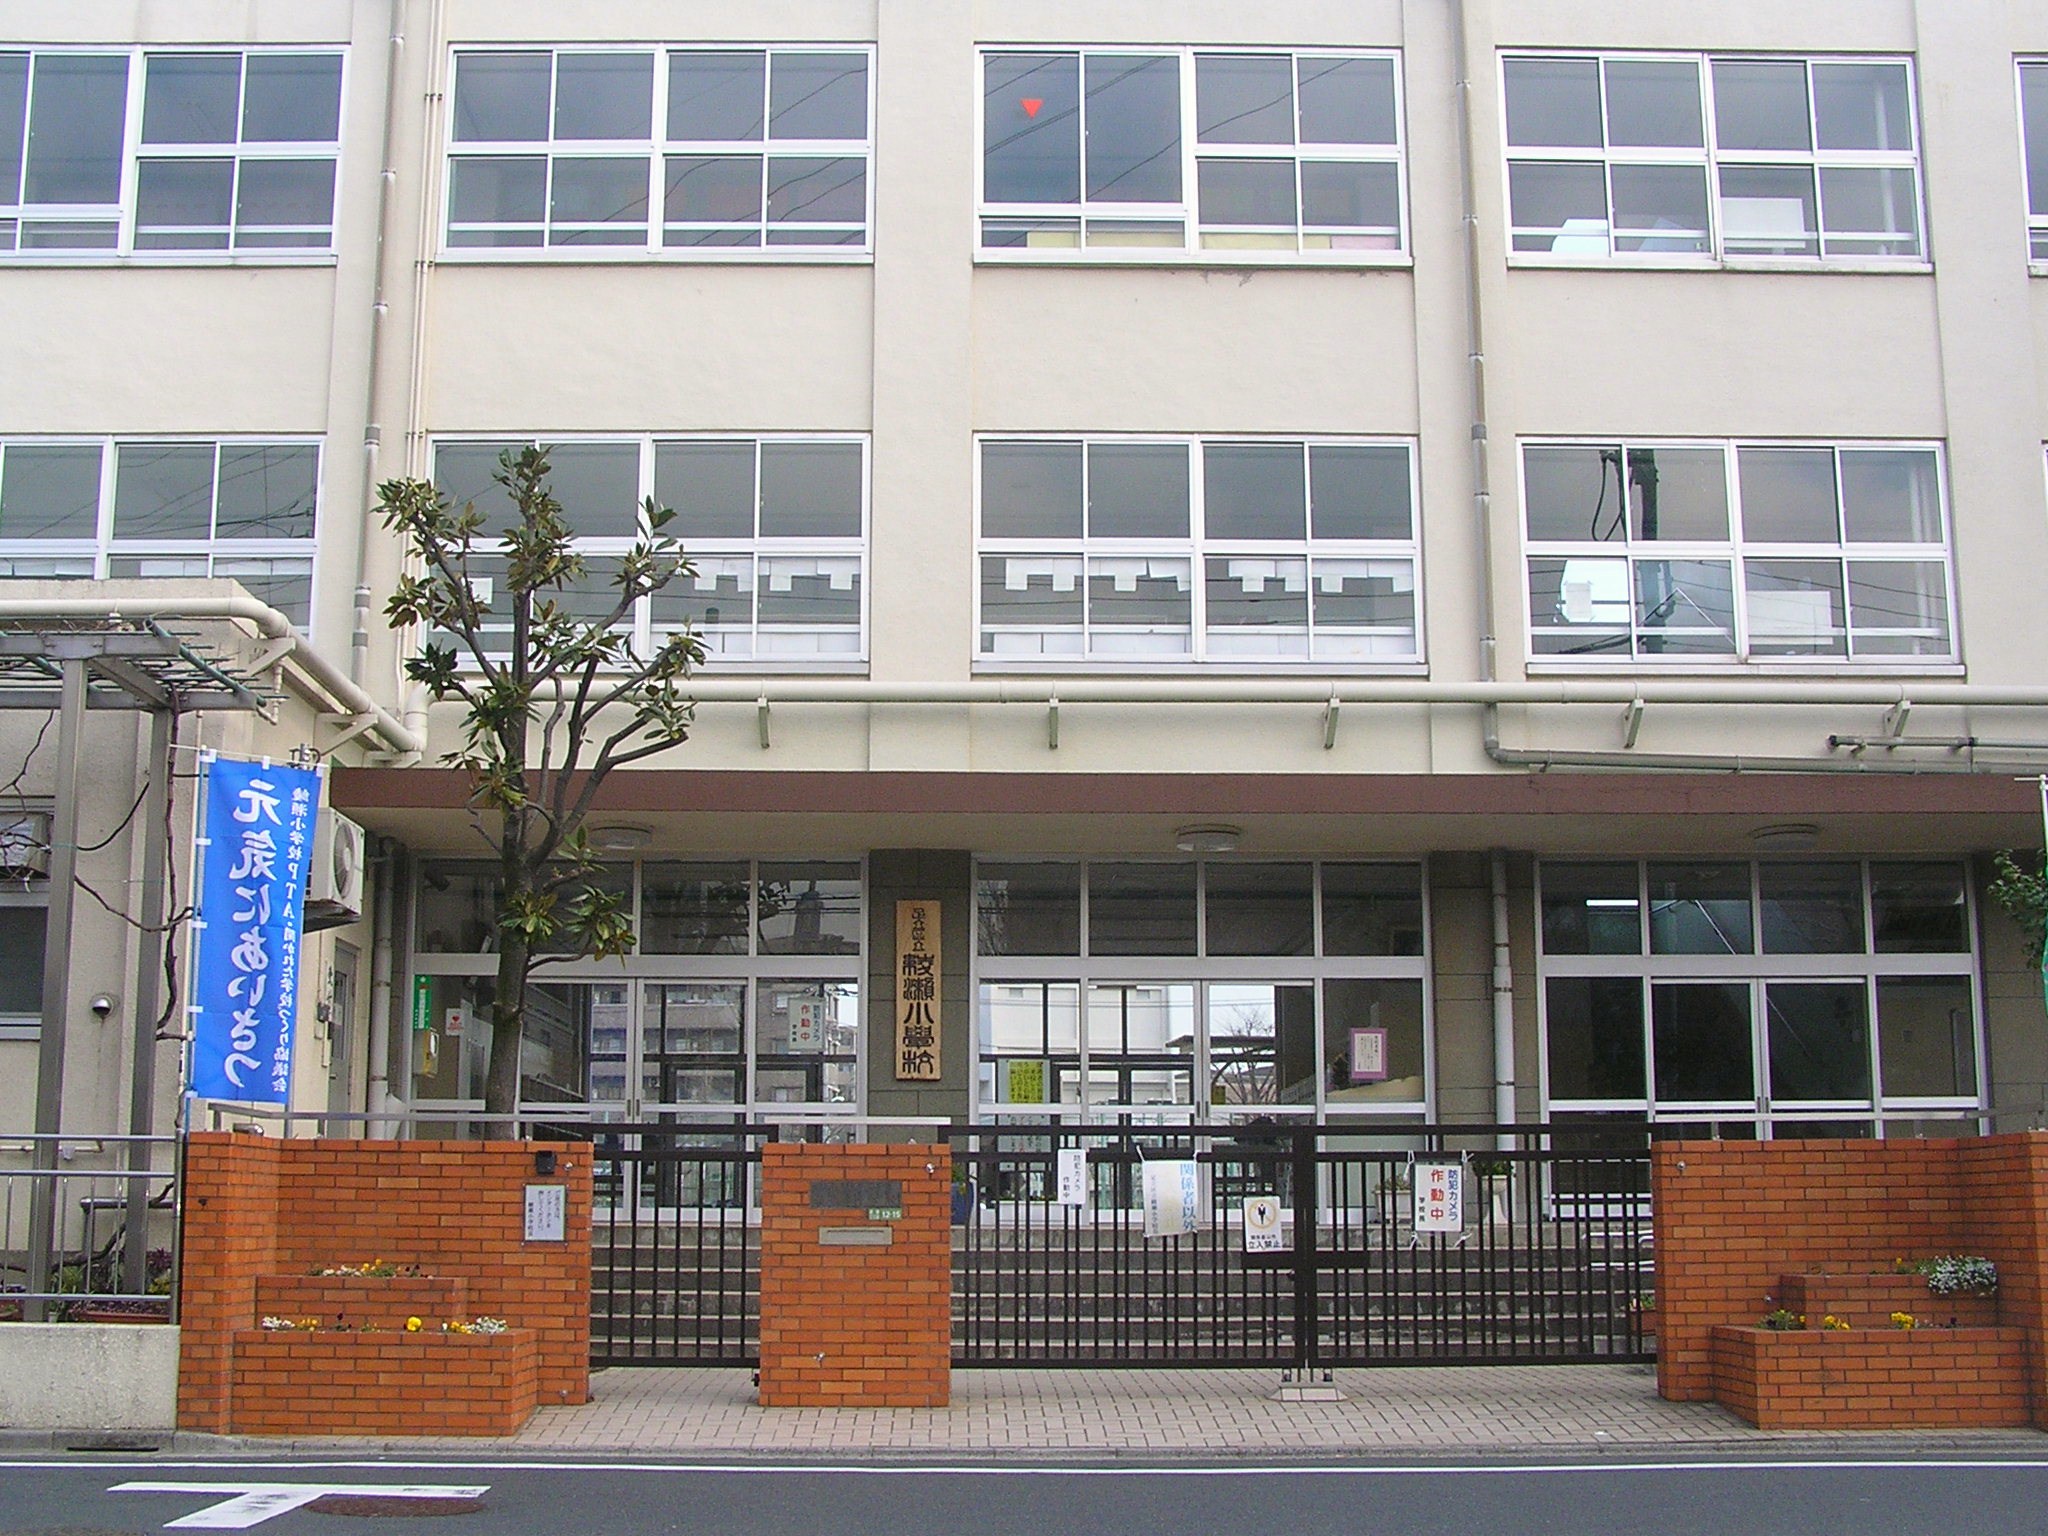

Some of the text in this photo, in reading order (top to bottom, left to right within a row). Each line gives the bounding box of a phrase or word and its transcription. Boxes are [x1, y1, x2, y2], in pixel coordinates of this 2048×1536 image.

[800, 1004, 810, 1041] 作動中
[1073, 1154, 1081, 1191] 防犯カメラ
[1430, 1169, 1444, 1220] 作動中
[1180, 1163, 1196, 1231] 関係者以外
[1447, 1169, 1459, 1222] 防犯カメラ
[1248, 1240, 1282, 1249] 立入禁止
